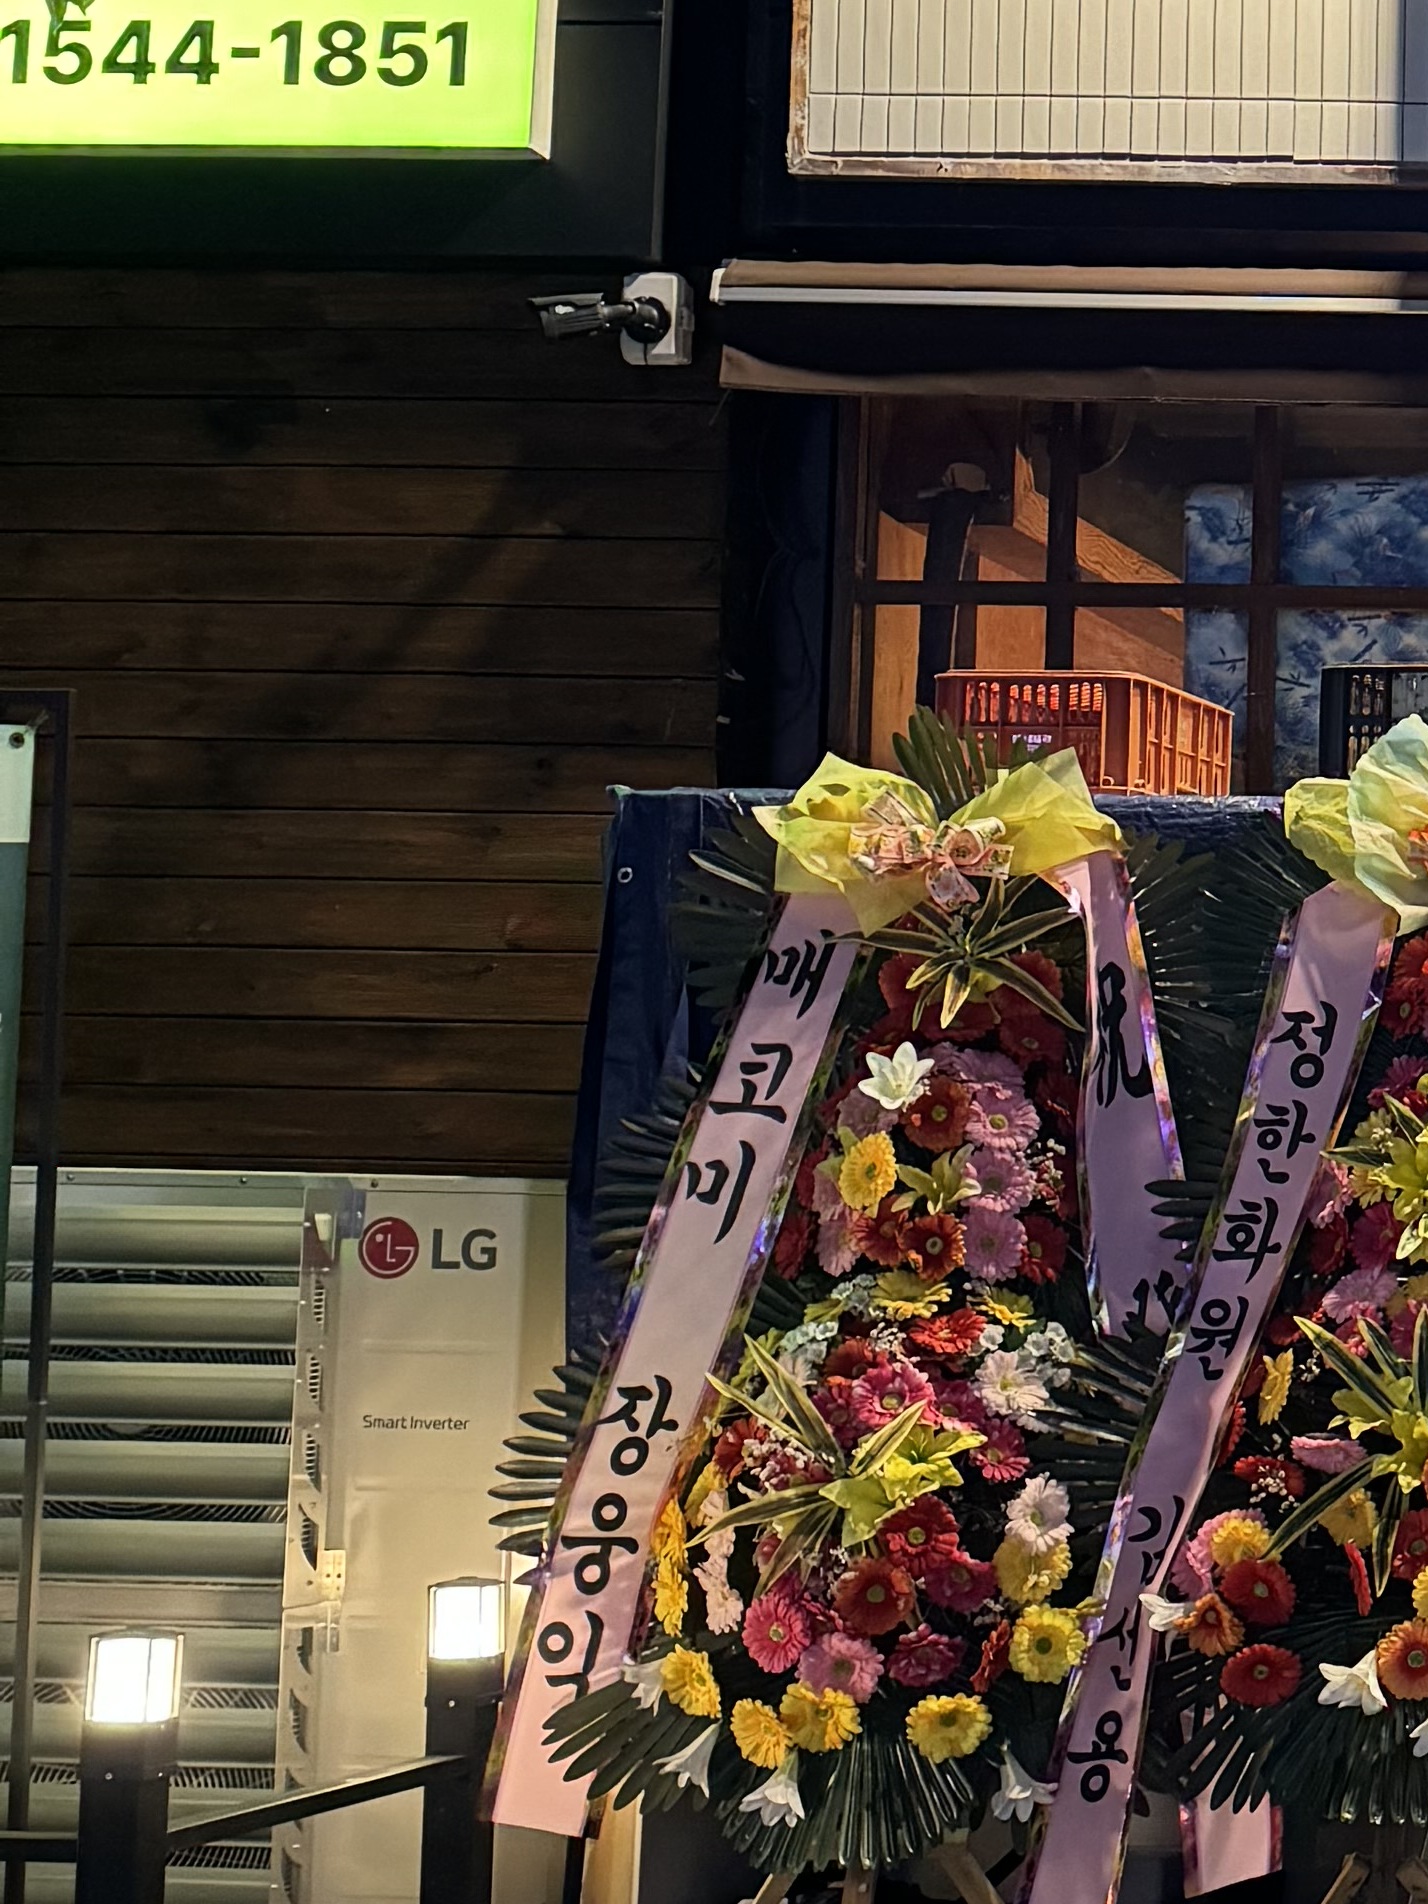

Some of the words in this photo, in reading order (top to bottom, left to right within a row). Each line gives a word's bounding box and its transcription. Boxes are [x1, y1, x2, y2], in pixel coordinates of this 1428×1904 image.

[0, 19, 469, 87] 1544-1851
[1185, 1000, 1339, 1381] 정한화원
[431, 1228, 498, 1271] LG
[362, 1414, 407, 1429] Smart
[410, 1415, 470, 1430] Inverter
